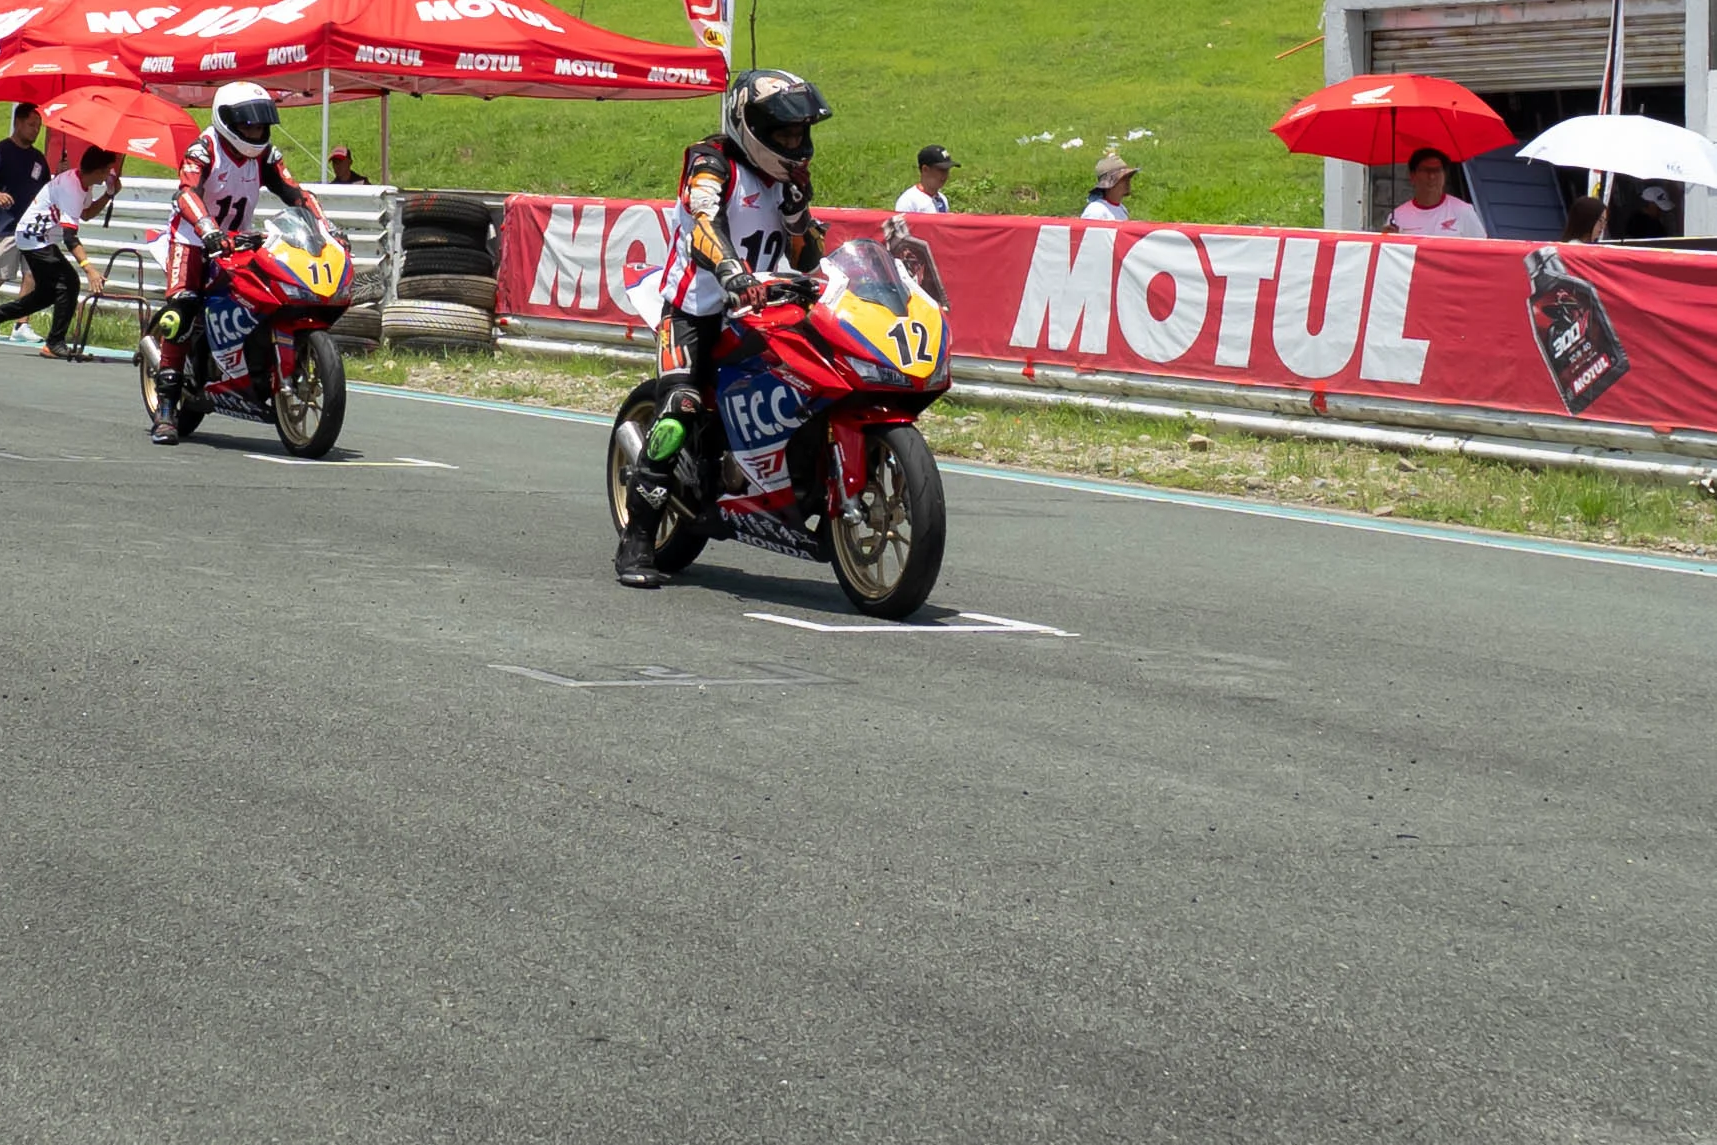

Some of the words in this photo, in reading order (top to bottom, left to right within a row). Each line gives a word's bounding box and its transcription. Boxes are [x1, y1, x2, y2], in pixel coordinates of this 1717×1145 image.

[141, 57, 174, 72] MOTUL
[200, 52, 237, 71] MOTUL
[267, 45, 308, 65] MOTUL
[355, 45, 423, 66] MOTUL
[455, 52, 522, 72] MOTUL
[554, 58, 618, 79] MOTUL
[647, 66, 711, 84] MOTUL
[215, 195, 247, 230] 11
[741, 230, 782, 272] 12
[308, 262, 332, 284] 11
[1009, 225, 1430, 384] MOTUL
[887, 321, 933, 367] 12
[1573, 356, 1609, 393] MOTUL
[736, 530, 815, 561] HONDA
